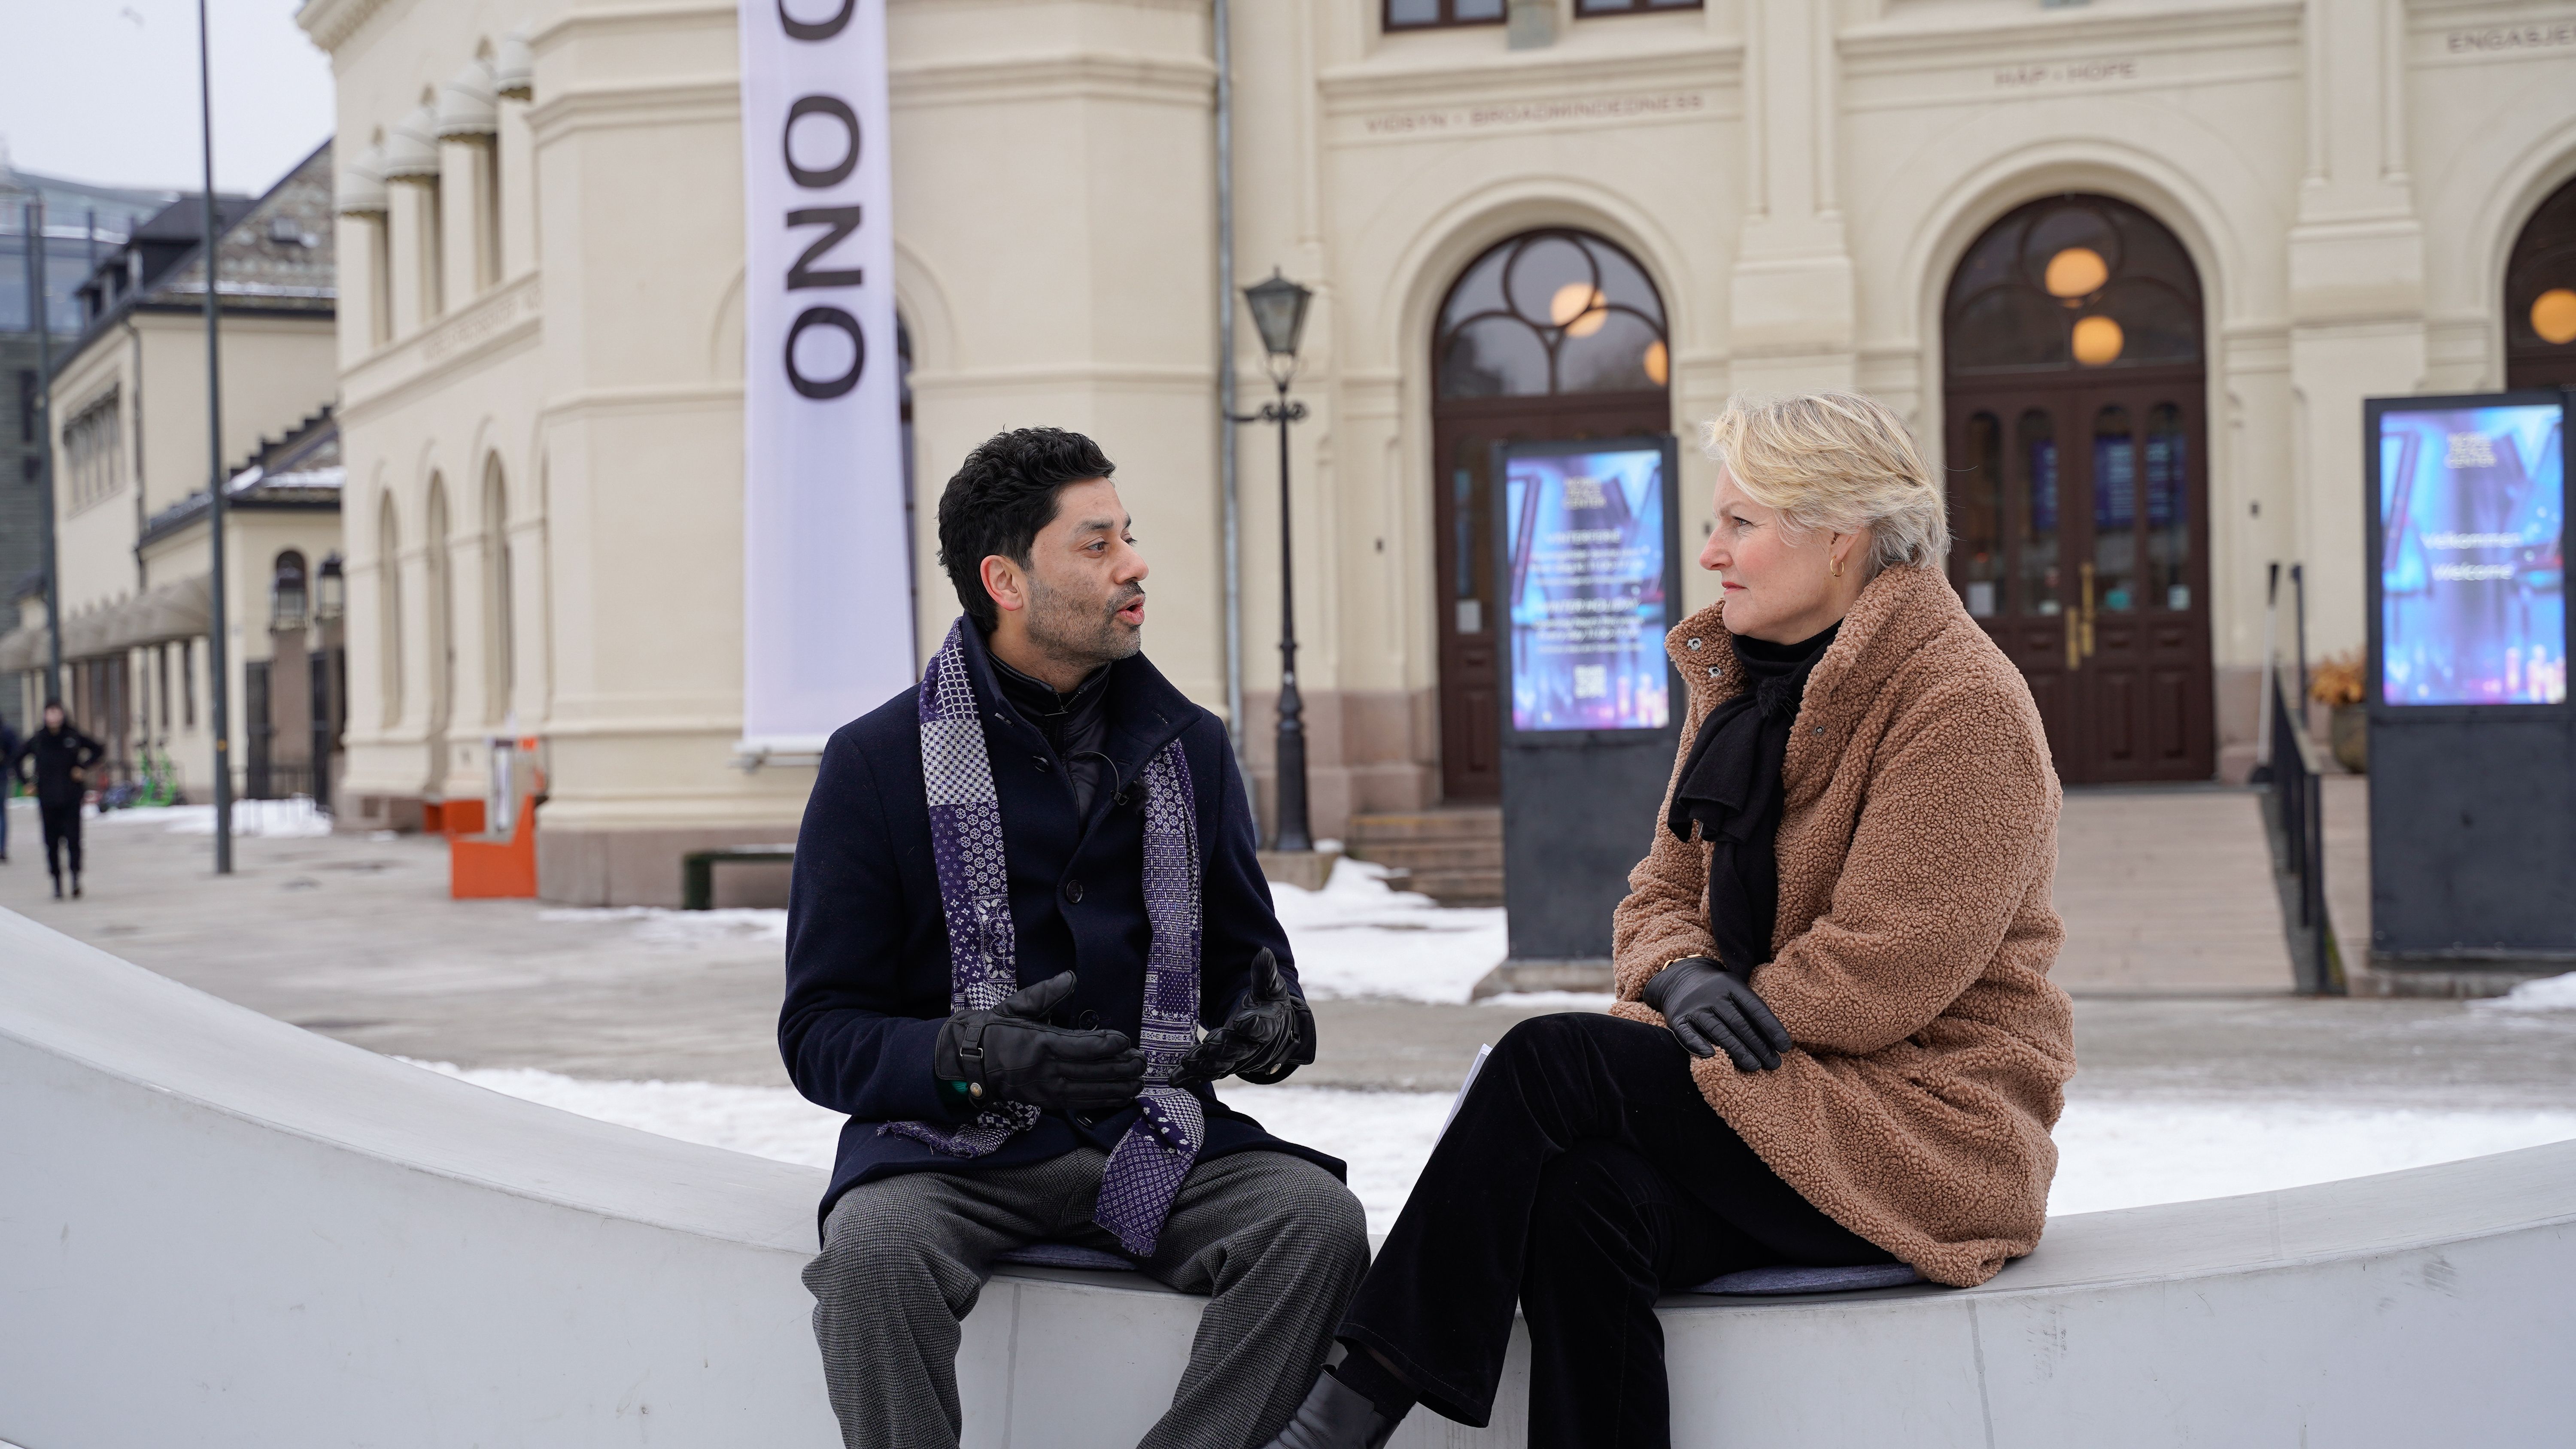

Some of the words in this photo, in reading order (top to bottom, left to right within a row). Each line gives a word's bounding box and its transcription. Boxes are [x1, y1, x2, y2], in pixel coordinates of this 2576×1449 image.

[2447, 25, 2576, 52] ENGASJE
[2067, 60, 2139, 82] HOPE
[1365, 113, 1448, 134] VIDSYN
[1468, 92, 1704, 126] BROADMINDEDNESS
[784, 96, 865, 400] ONO
[2420, 532, 2522, 549] Velkommen
[2432, 563, 2518, 580] Welcome
